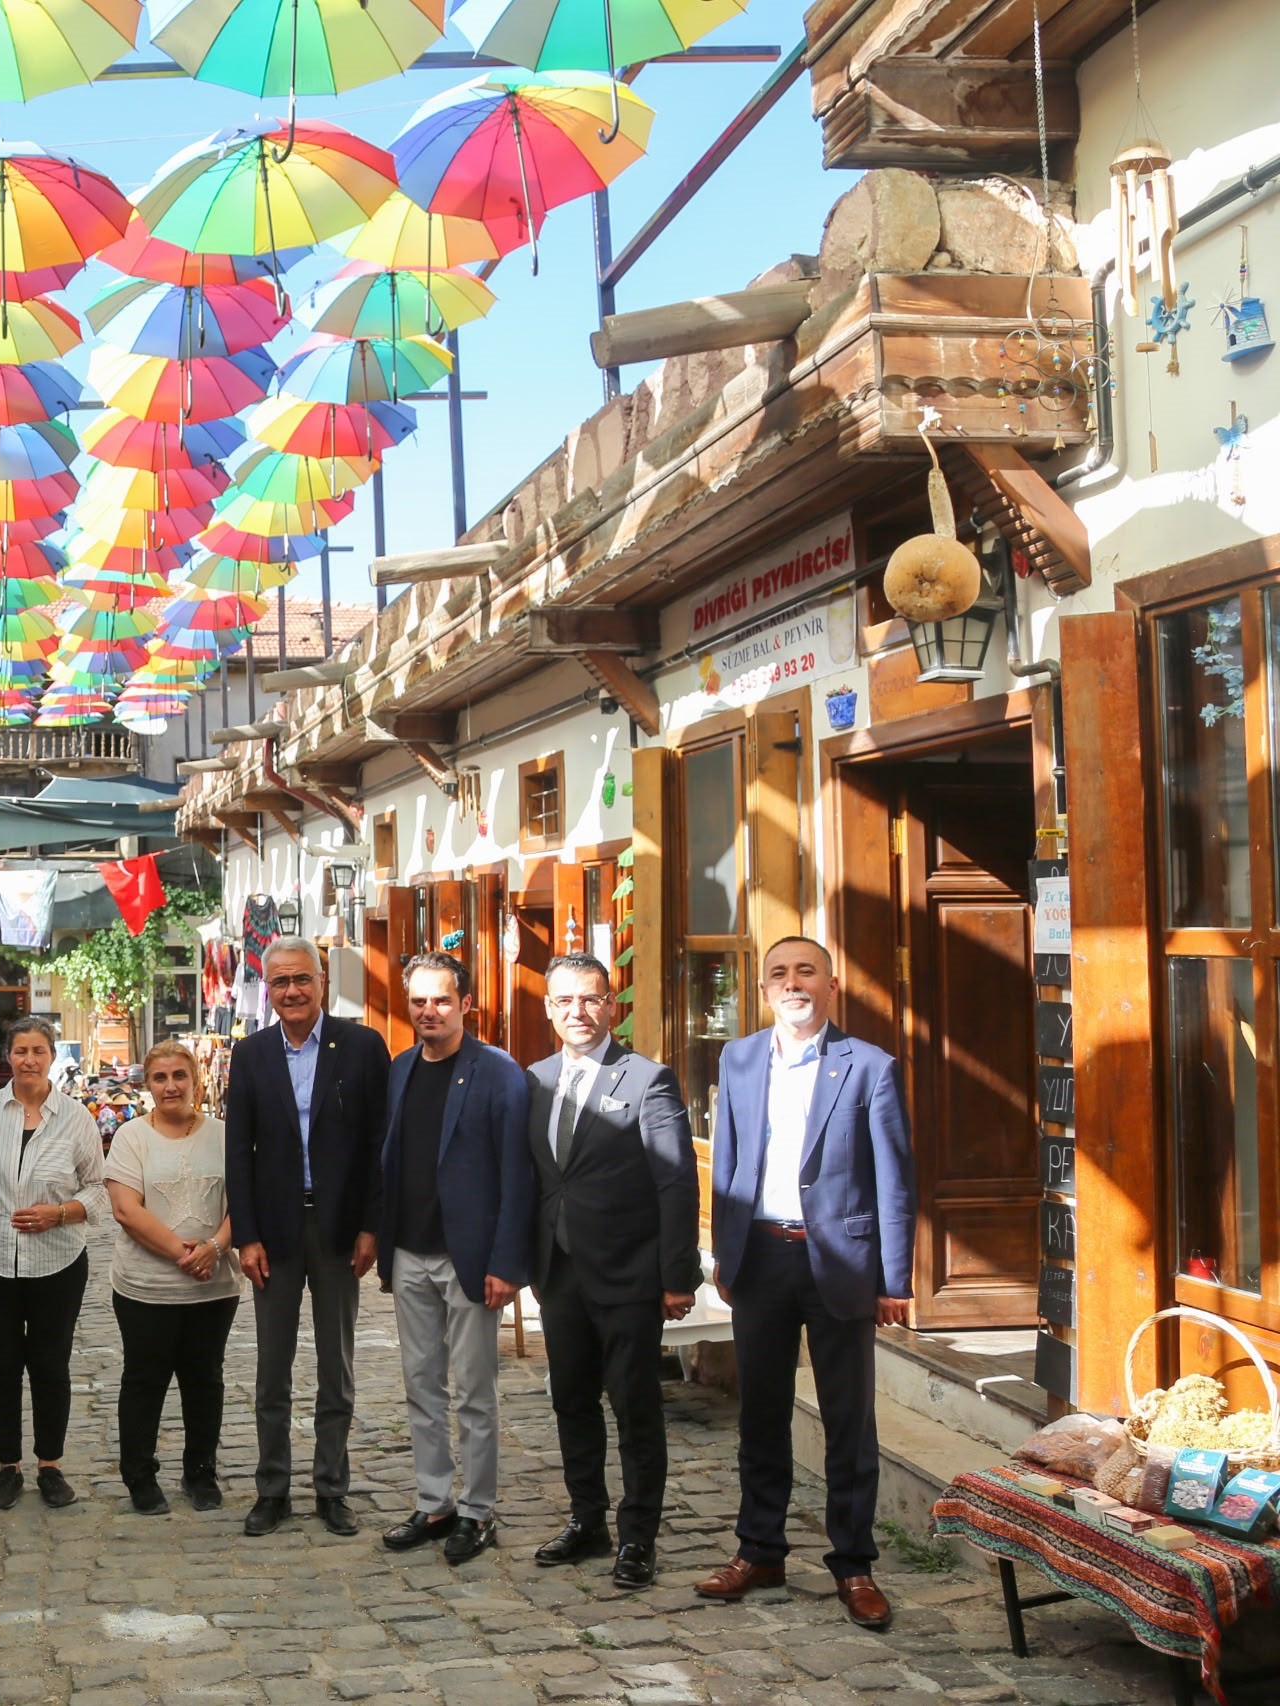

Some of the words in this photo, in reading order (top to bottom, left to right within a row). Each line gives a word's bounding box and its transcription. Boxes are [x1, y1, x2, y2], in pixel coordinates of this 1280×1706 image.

[693, 576, 748, 632] DİVRİĞİ
[751, 526, 851, 603] PEYNİRCİSİ
[721, 641, 752, 672] SÜZME
[753, 640, 771, 664] BAL
[773, 634, 782, 651] &
[783, 615, 824, 647] PEYNİR
[784, 658, 798, 677] 93
[800, 651, 815, 672] 20
[1044, 891, 1056, 903] Ev
[1058, 890, 1070, 902] Ya
[1044, 904, 1071, 921] YOĞ
[1048, 927, 1071, 940] Bulu
[1048, 1144, 1076, 1183] PE
[1048, 1210, 1077, 1252] KA
